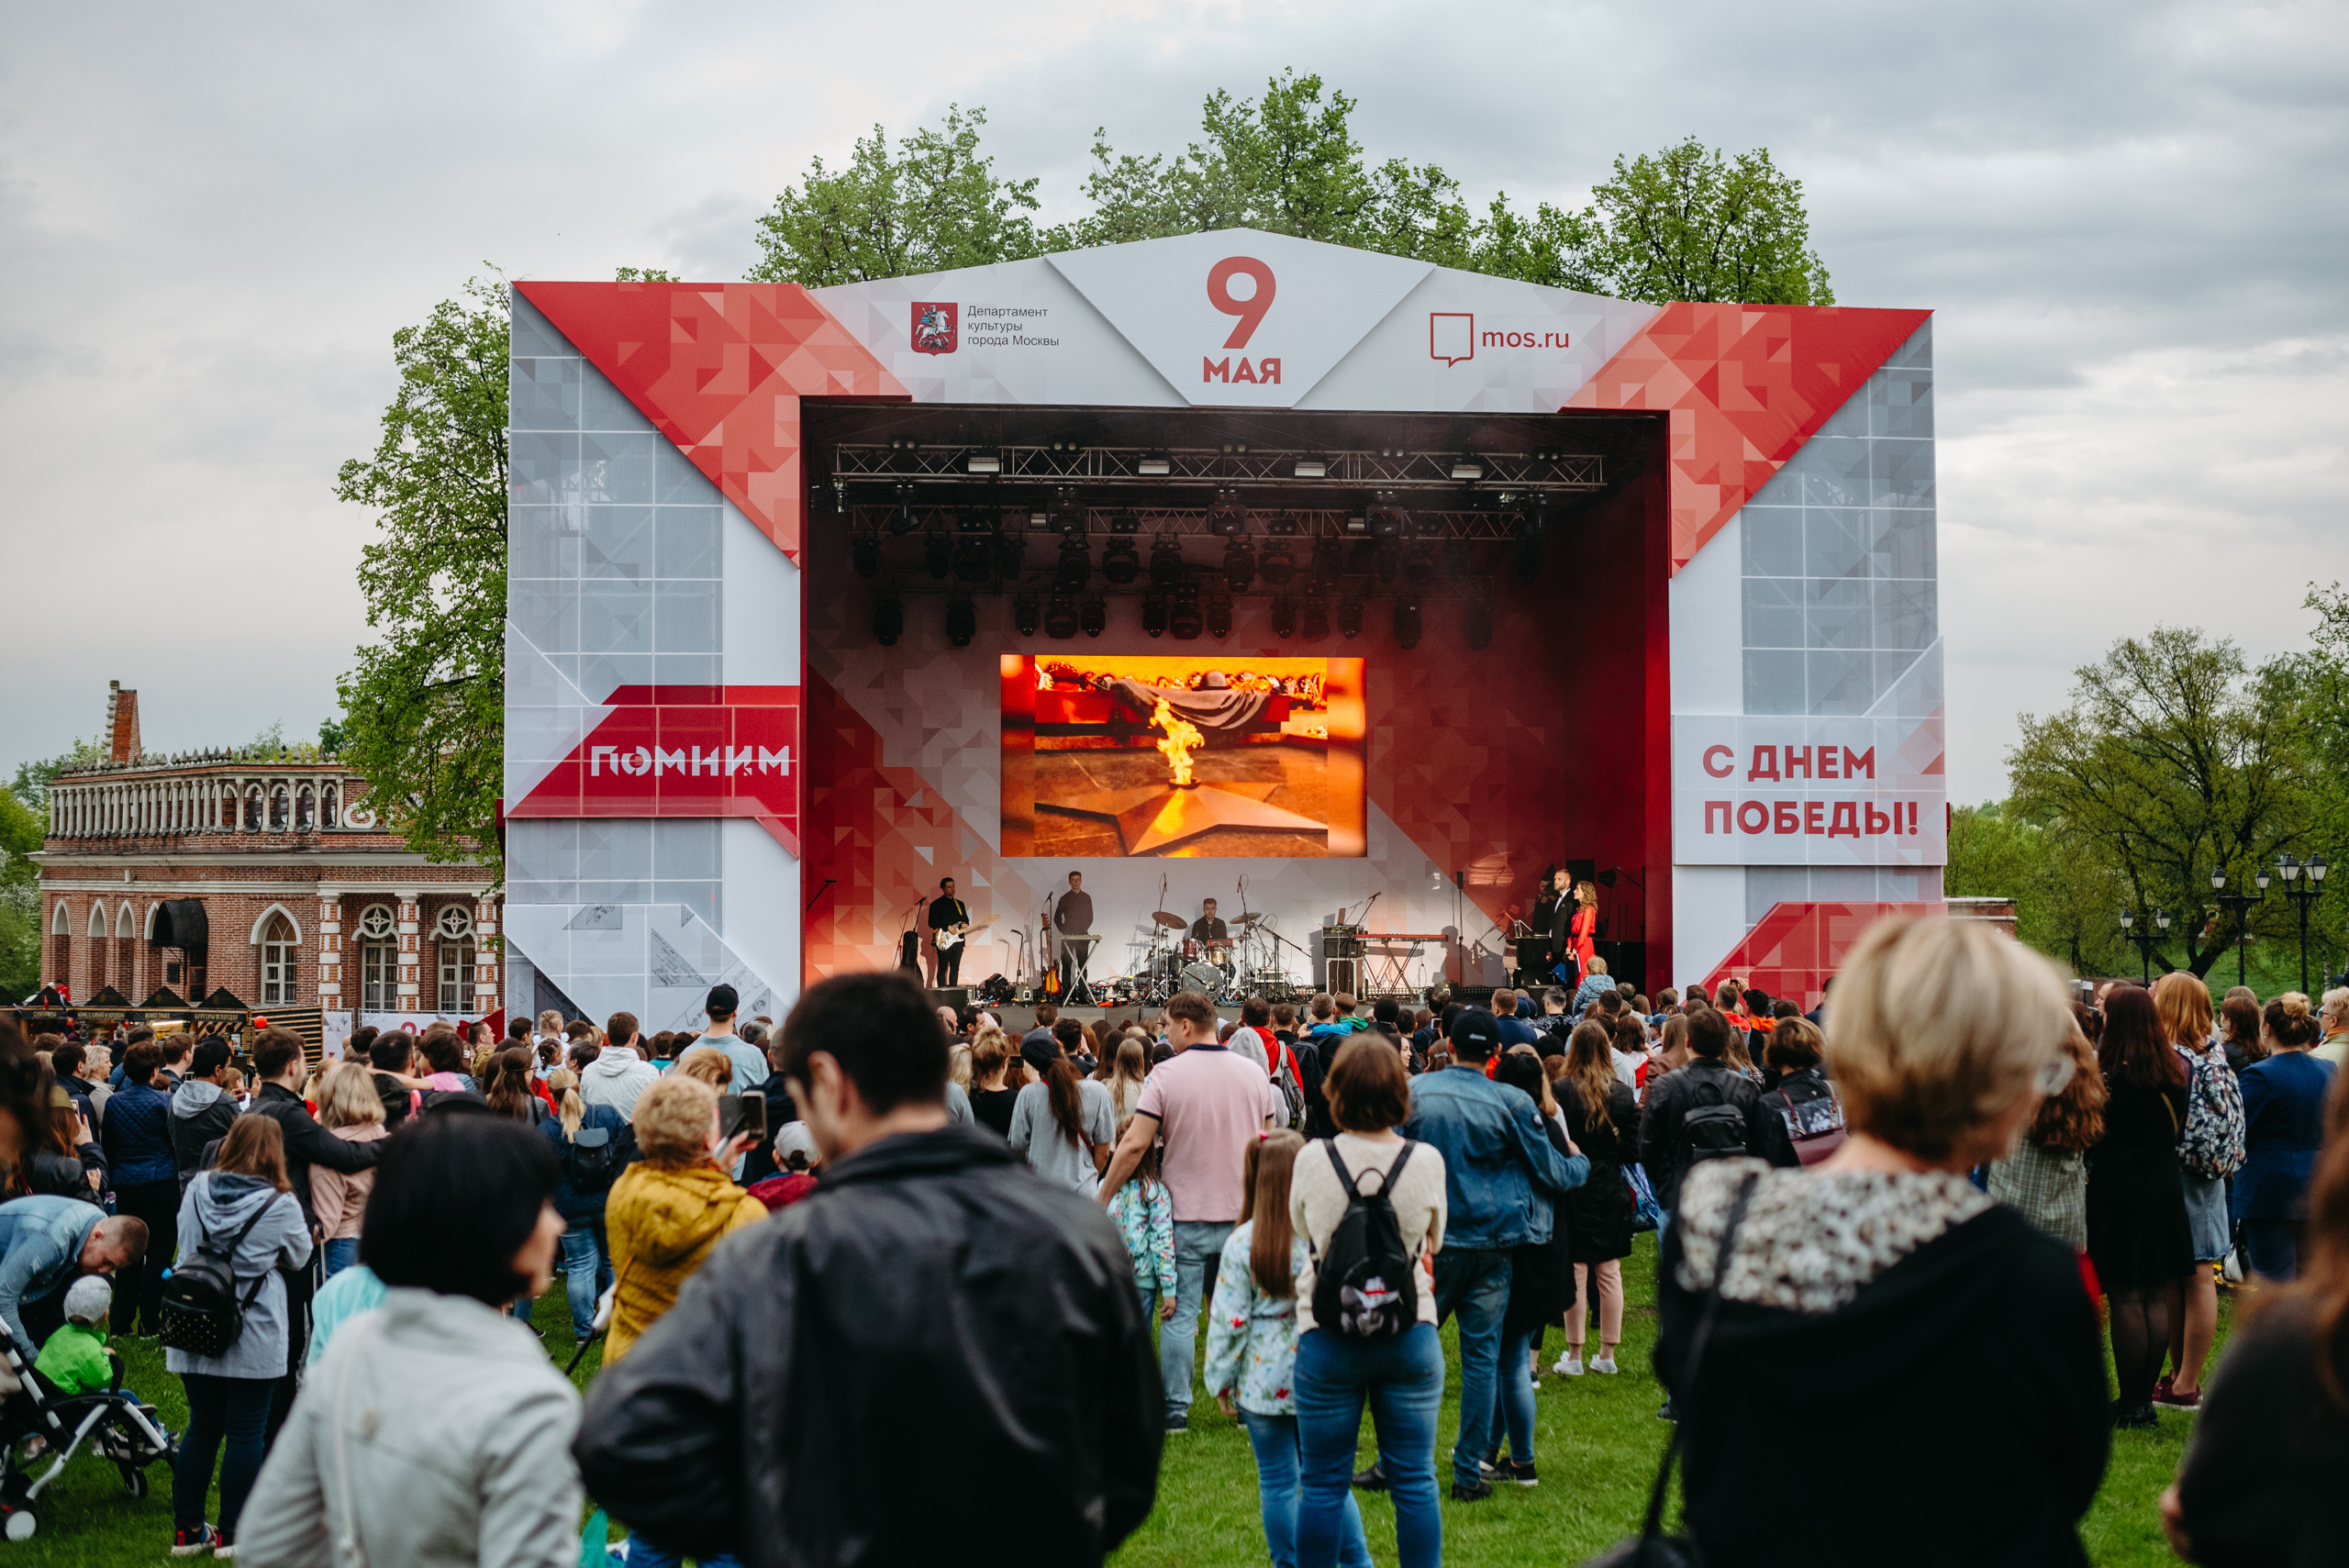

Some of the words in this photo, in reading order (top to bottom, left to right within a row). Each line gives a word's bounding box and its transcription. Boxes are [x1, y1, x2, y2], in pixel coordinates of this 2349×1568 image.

[967, 306, 1048, 318] Департамент
[1207, 255, 1276, 350] 9
[967, 322, 1023, 333] культуры
[967, 336, 1008, 347] города
[1012, 335, 1060, 346] Москвы
[1482, 331, 1569, 349] mos.ru
[1203, 356, 1281, 384] МАЯ
[590, 745, 790, 777] ПОМНИМ
[1702, 744, 1735, 779] С
[1747, 744, 1876, 783] ДНЕМ
[1704, 800, 1919, 839] ПОБЕДЫ!
